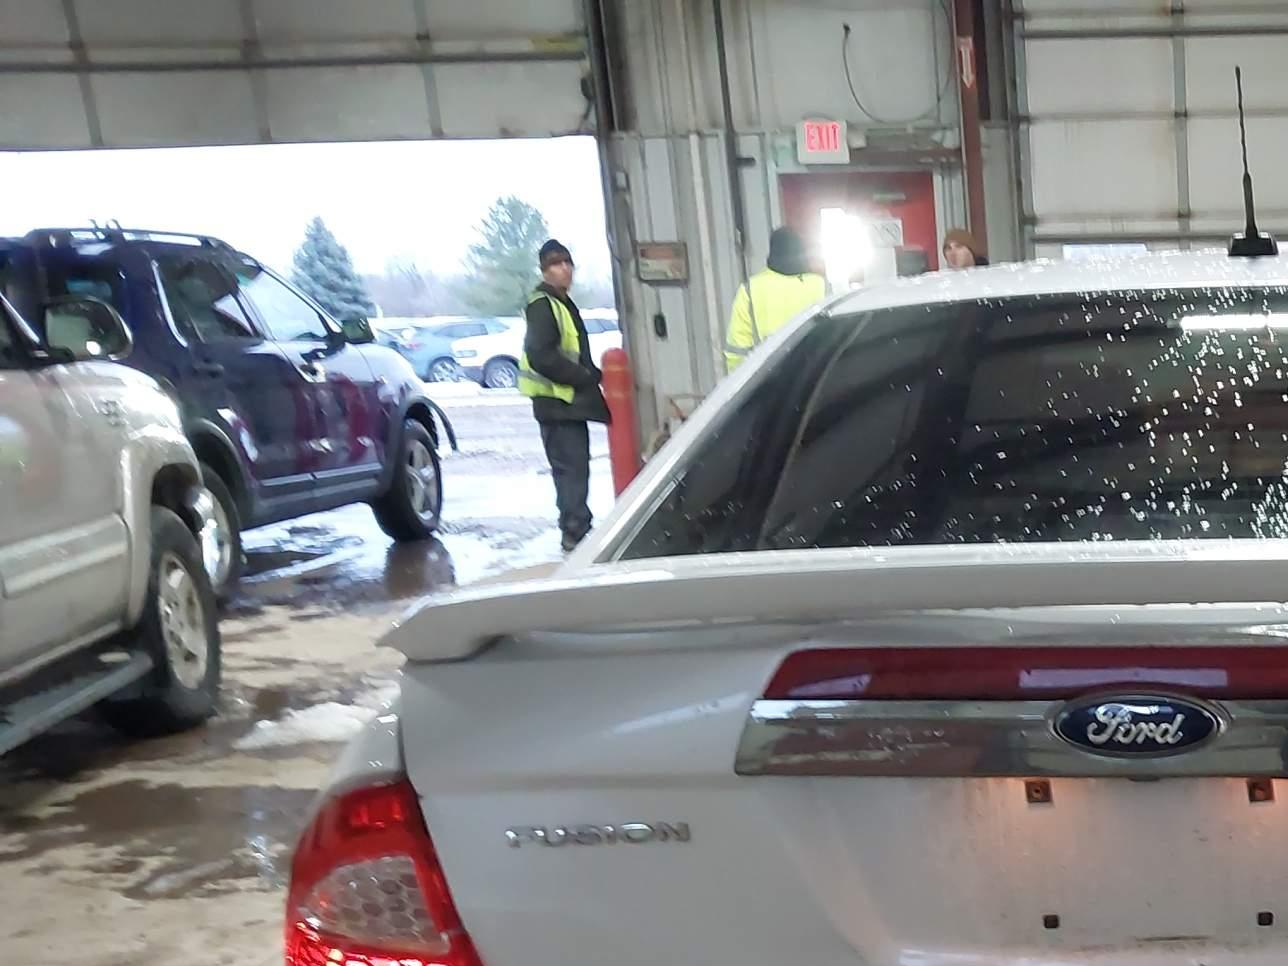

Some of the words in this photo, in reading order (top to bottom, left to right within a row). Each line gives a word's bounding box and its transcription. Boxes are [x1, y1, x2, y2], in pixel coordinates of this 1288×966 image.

[804, 122, 840, 152] EXIT
[1086, 702, 1186, 745] Ford
[504, 821, 692, 849] FUSION
